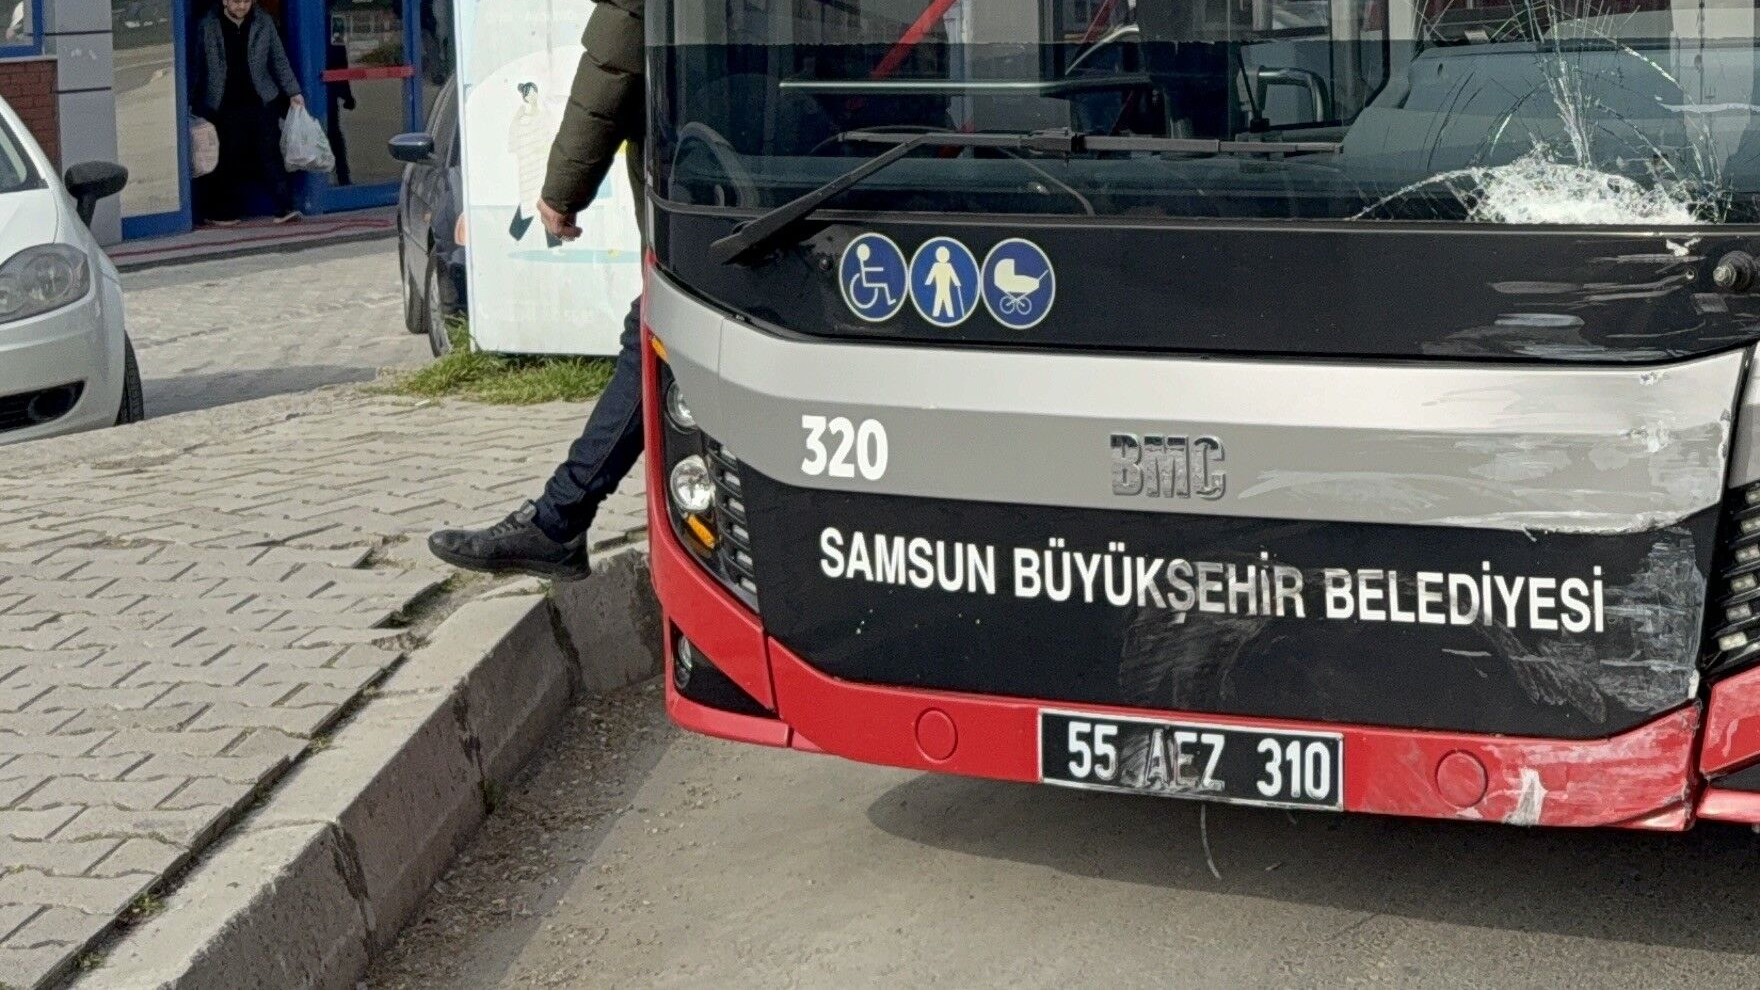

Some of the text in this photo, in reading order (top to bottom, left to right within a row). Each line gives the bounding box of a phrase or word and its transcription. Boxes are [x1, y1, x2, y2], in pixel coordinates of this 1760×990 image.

[801, 414, 888, 481] 320
[1110, 433, 1227, 500] BMC
[819, 526, 1604, 633] SAMSUN BÜYÜKŞEHİR BELEDİYESİ
[1068, 721, 1118, 781] 55
[1256, 737, 1331, 800] 310
